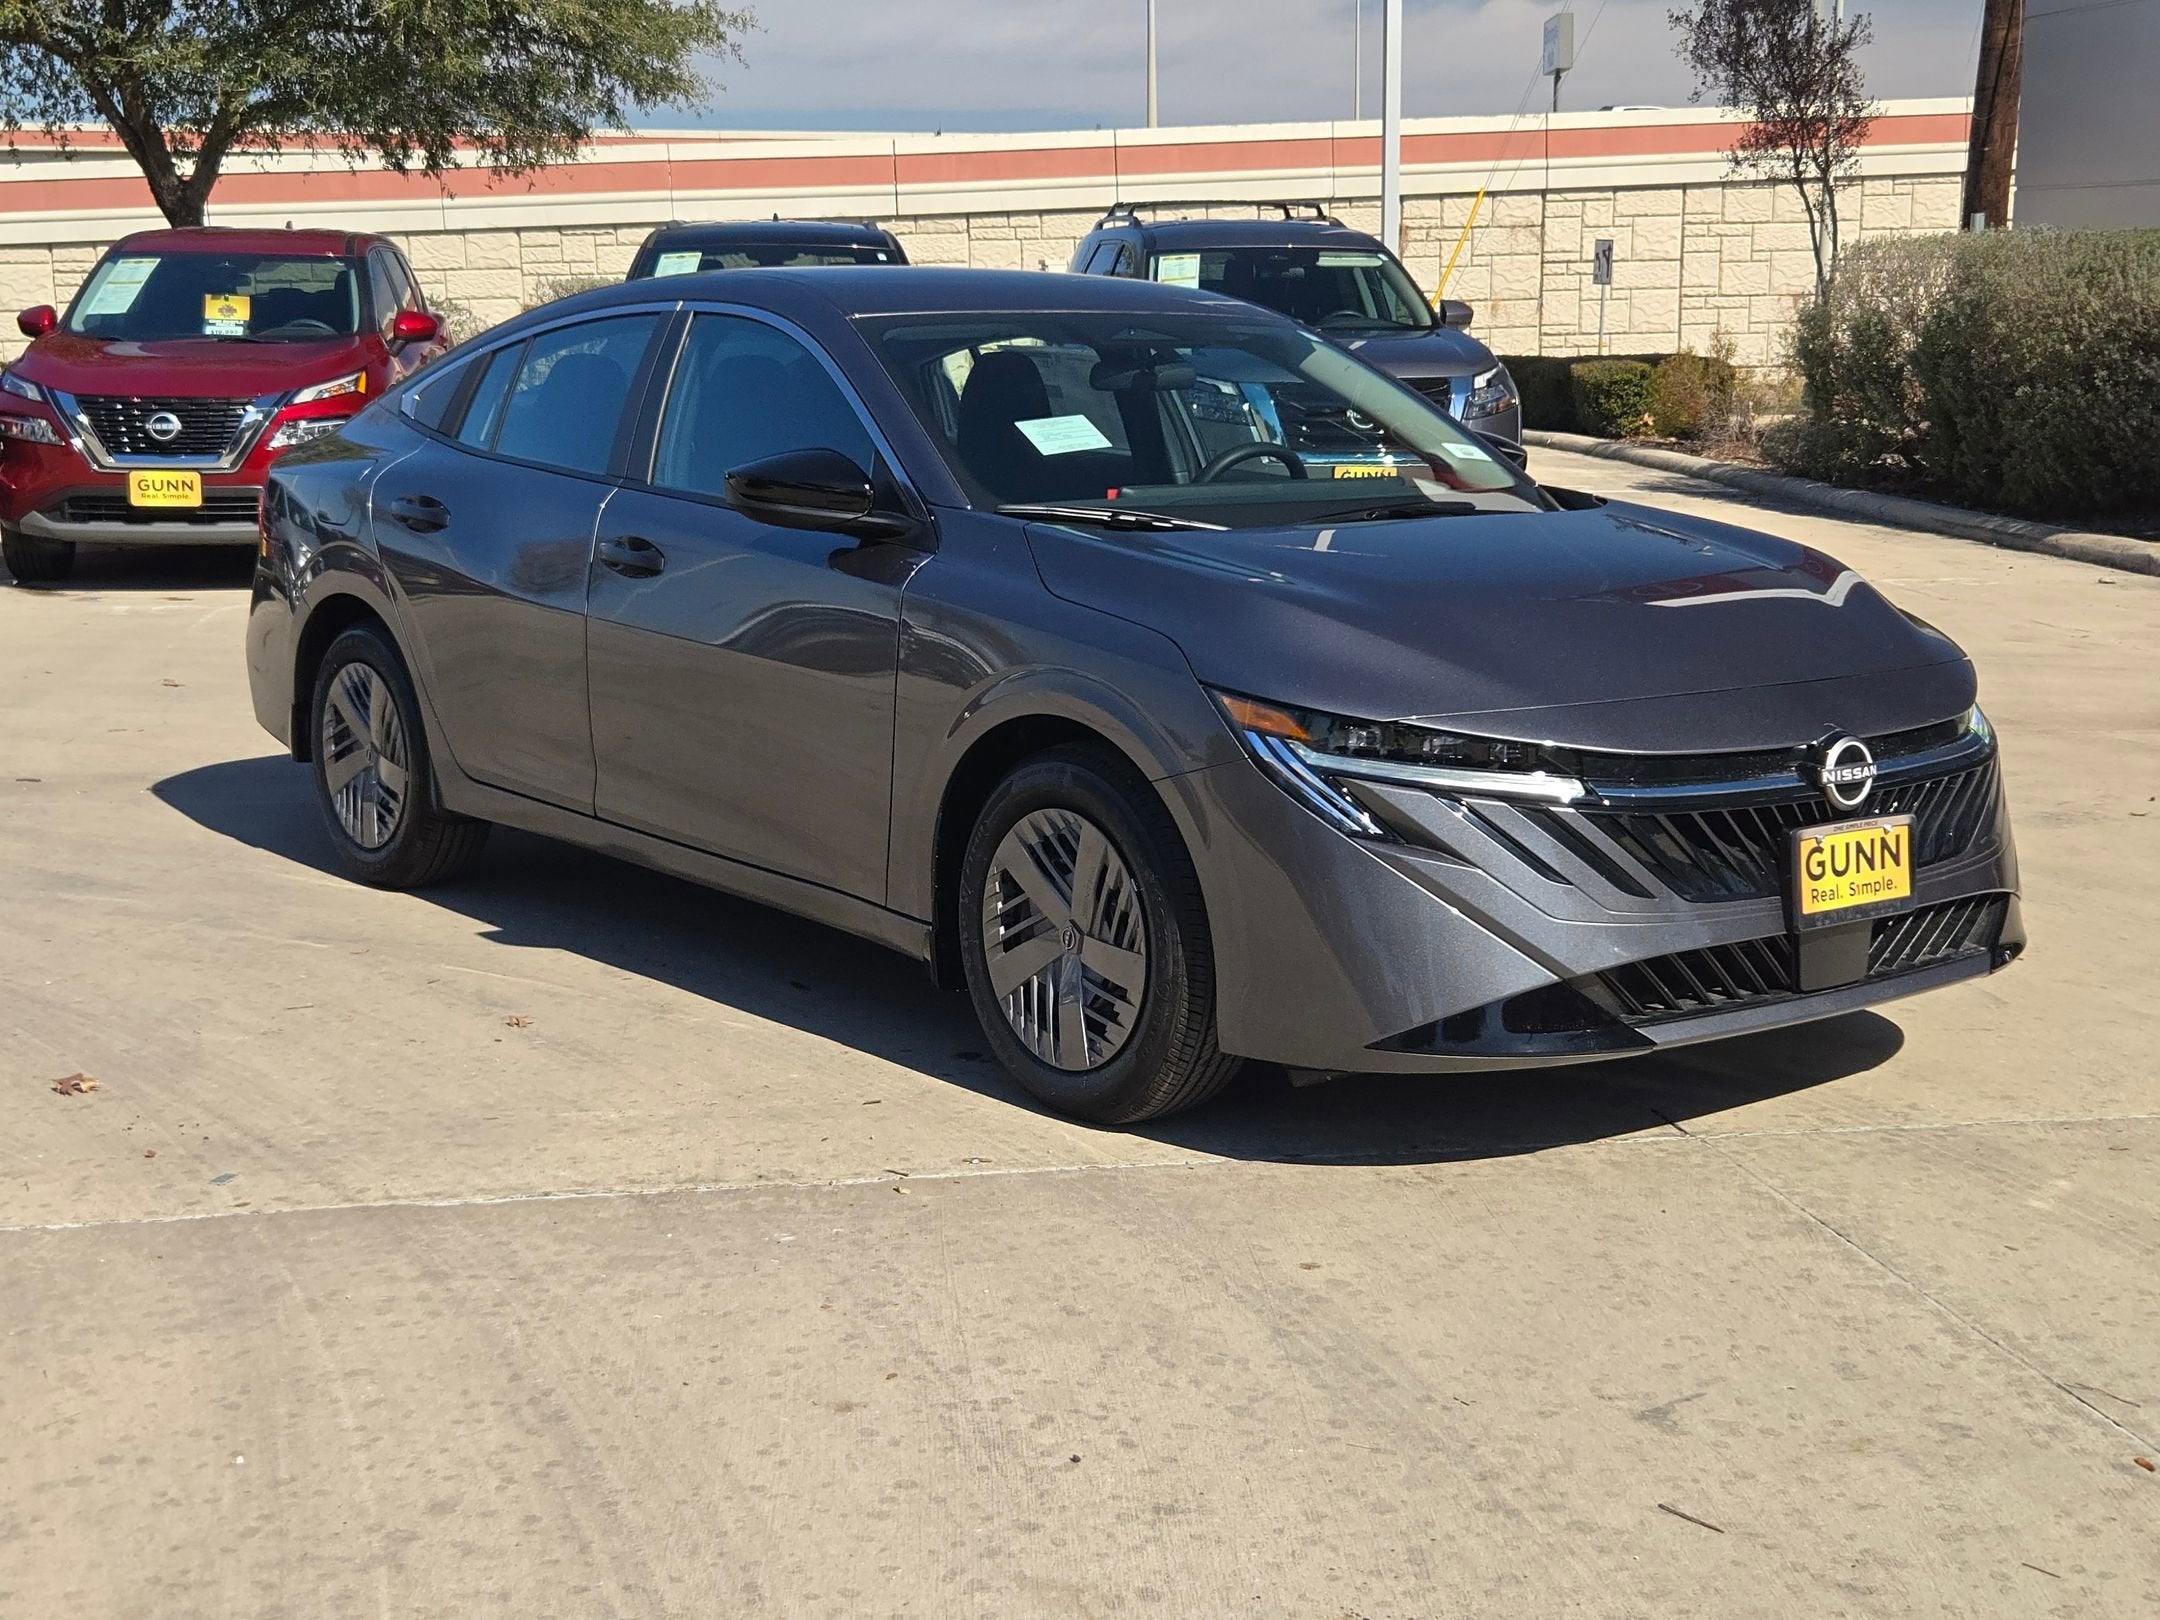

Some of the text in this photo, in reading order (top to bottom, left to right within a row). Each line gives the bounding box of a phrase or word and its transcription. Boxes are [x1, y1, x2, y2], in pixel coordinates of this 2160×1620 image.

[137, 479, 194, 492] GUNN
[1821, 764, 1877, 783] NISSAN
[1805, 833, 1901, 881] GUNN
[1811, 876, 1897, 904] Real. Simple.
